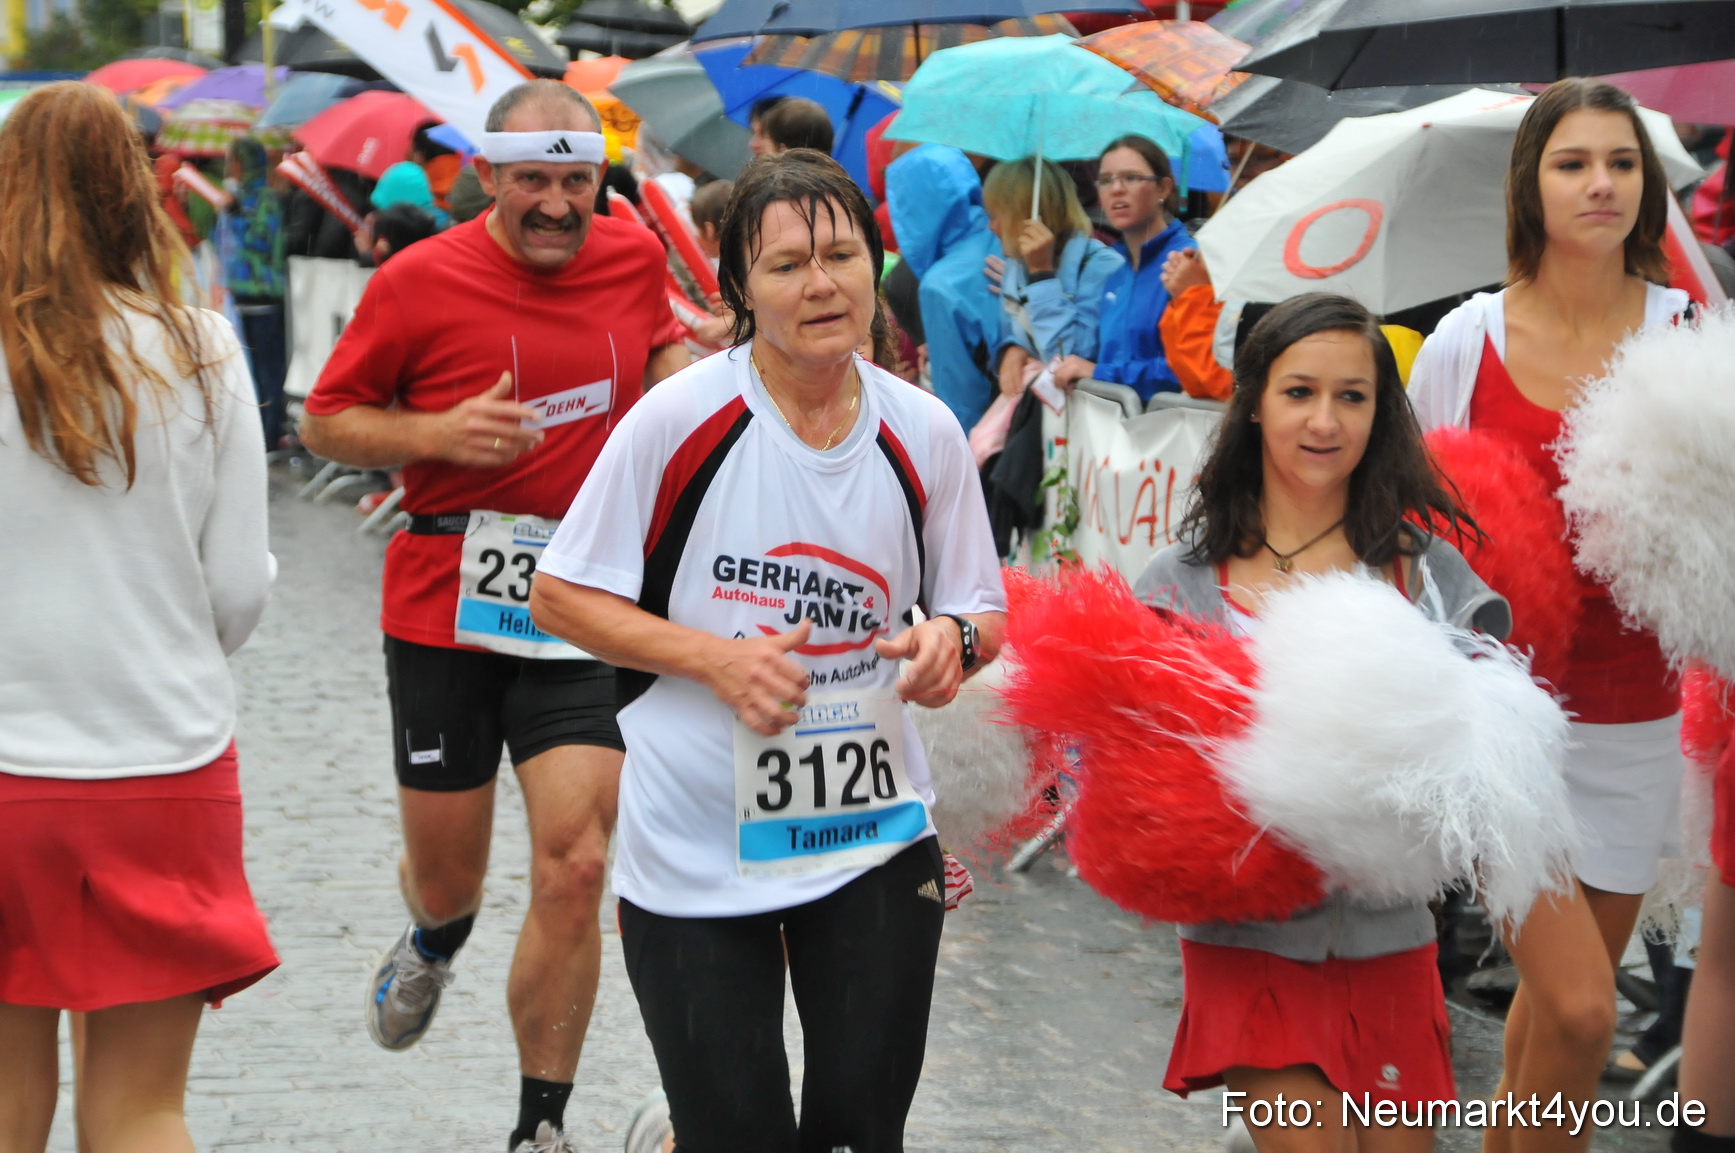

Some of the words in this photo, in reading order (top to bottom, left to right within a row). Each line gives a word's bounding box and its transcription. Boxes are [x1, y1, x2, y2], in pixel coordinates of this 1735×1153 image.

[545, 395, 587, 418] DEHN
[712, 554, 864, 605] GERHART
[711, 586, 786, 609] Autohaus
[863, 595, 875, 609] &
[756, 738, 898, 811] 3126
[786, 820, 879, 850] Tamara
